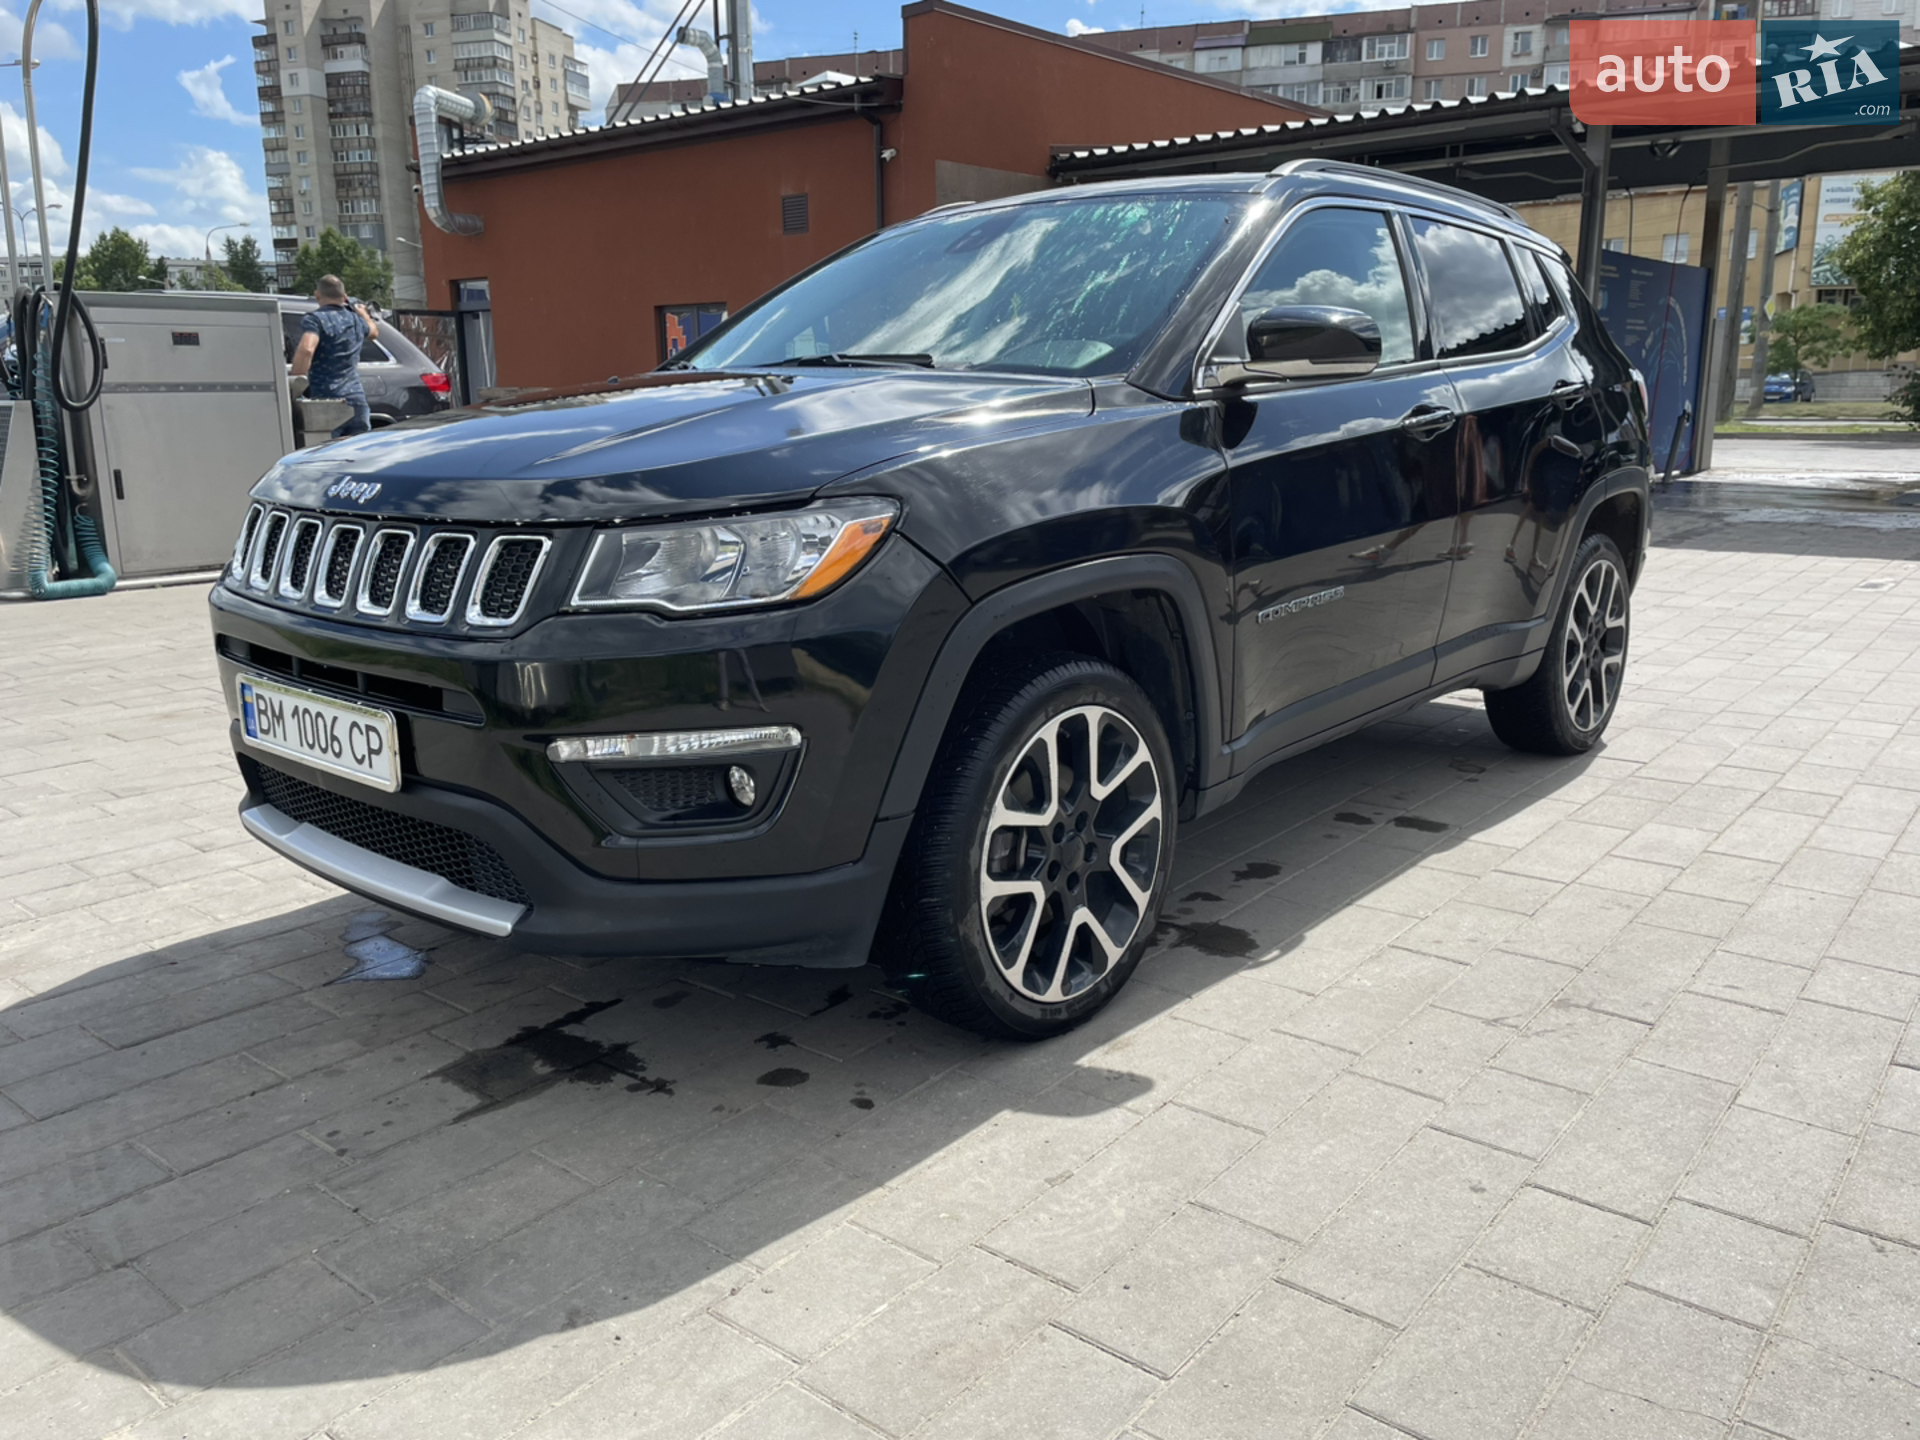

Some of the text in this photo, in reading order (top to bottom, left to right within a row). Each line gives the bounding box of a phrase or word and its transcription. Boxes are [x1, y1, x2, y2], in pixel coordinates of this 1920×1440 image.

[327, 476, 381, 505] Jeep
[255, 692, 383, 769] BM 1006 CP
